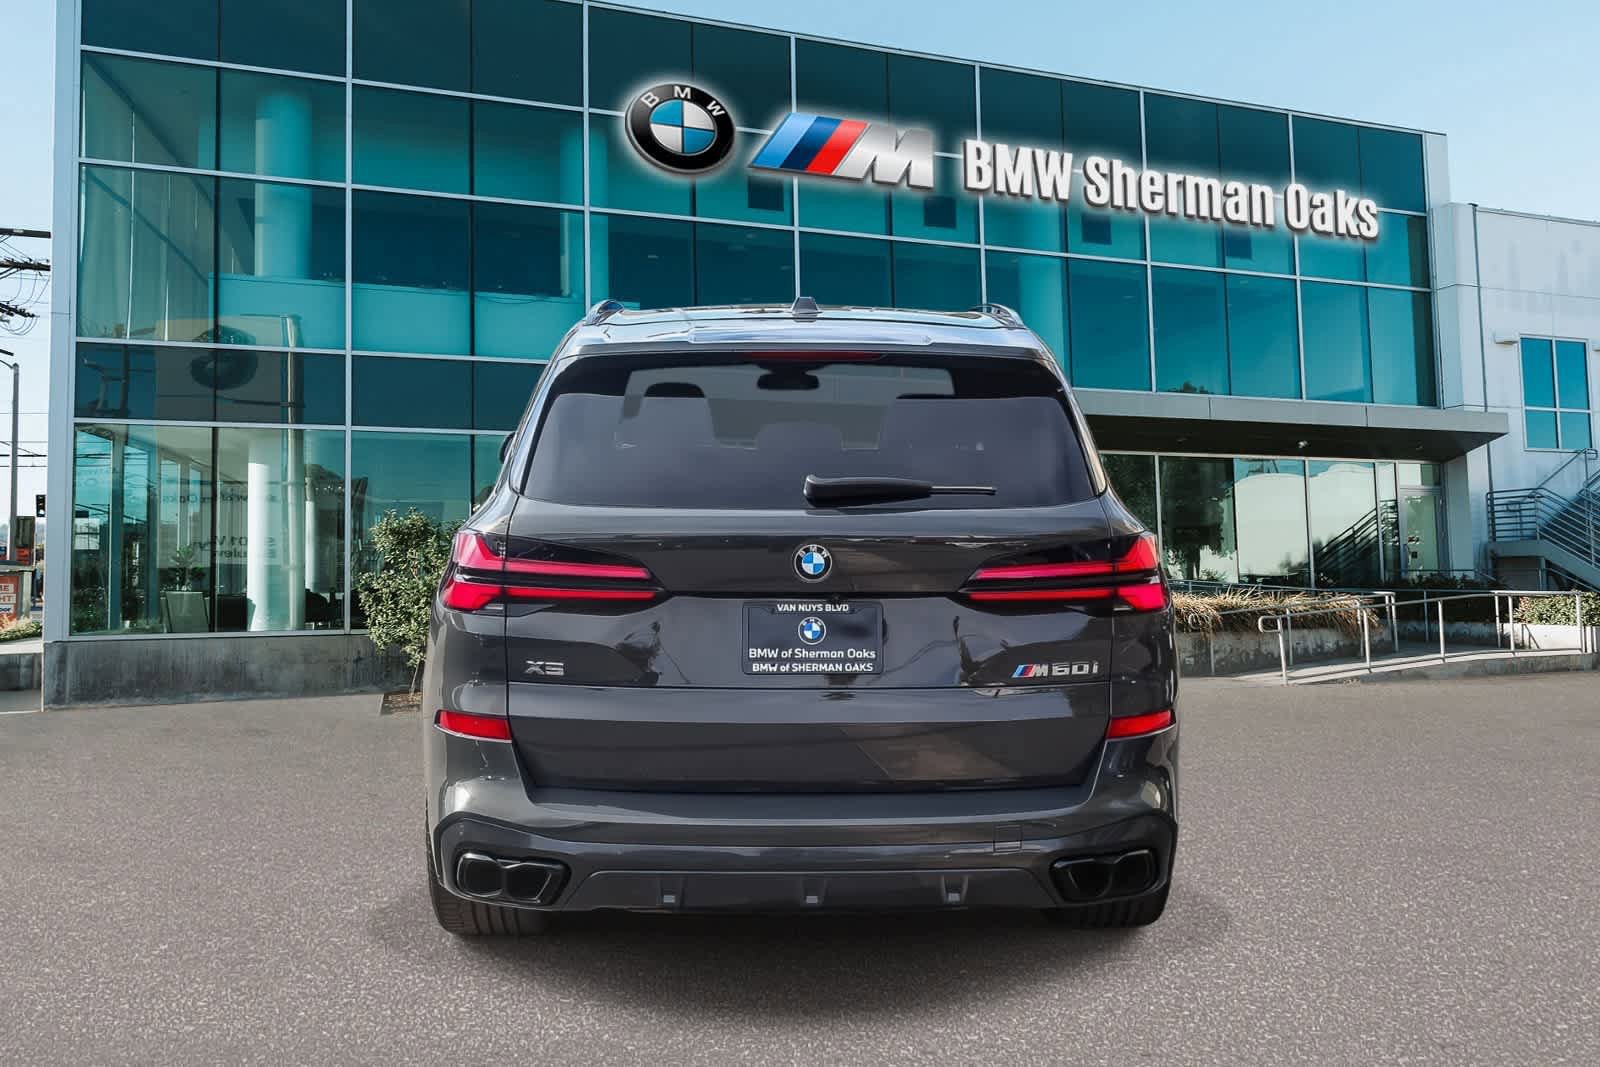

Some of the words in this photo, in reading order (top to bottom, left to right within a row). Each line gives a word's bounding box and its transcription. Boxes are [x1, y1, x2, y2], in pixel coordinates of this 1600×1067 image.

[641, 85, 726, 117] BMW
[963, 138, 1073, 203] BMW
[1082, 155, 1275, 227] Sherman
[1284, 182, 1379, 240] Oaks
[776, 604, 796, 612] VAN
[798, 604, 823, 612] NUYS
[825, 604, 849, 612] BLVD
[748, 648, 778, 659] BMW
[781, 648, 793, 659] of
[794, 648, 844, 659] Sherman
[847, 648, 876, 659] Oaks
[752, 663, 778, 672] BMW
[780, 663, 790, 672] of
[791, 663, 843, 672] SHERMAN
[845, 663, 873, 672] OAKS
